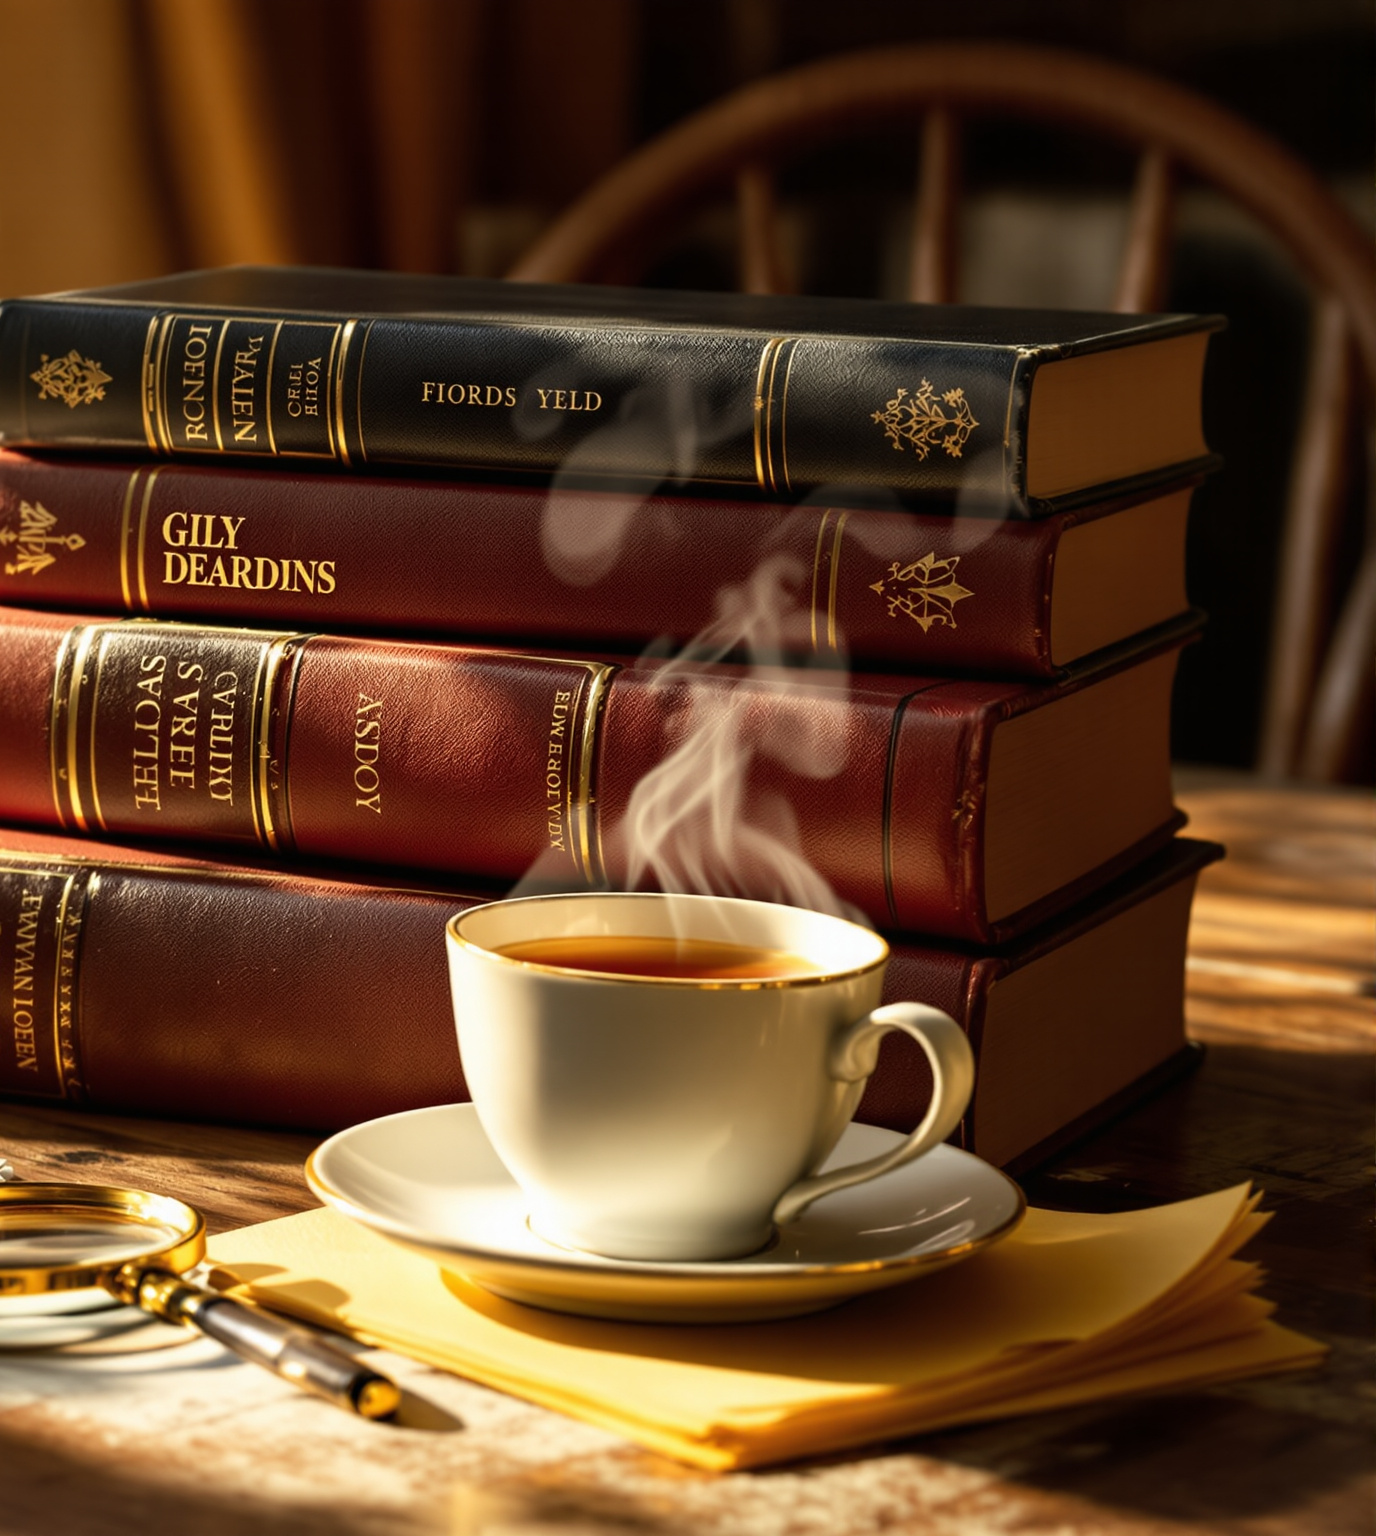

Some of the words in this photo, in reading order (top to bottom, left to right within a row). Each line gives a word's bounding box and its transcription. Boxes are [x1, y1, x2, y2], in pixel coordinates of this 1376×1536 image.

[421, 381, 516, 408] FIORDS
[536, 388, 603, 412] YELD
[162, 511, 246, 551] GILY
[162, 551, 336, 595] DEARDINS
[354, 693, 384, 815] ASDOY
